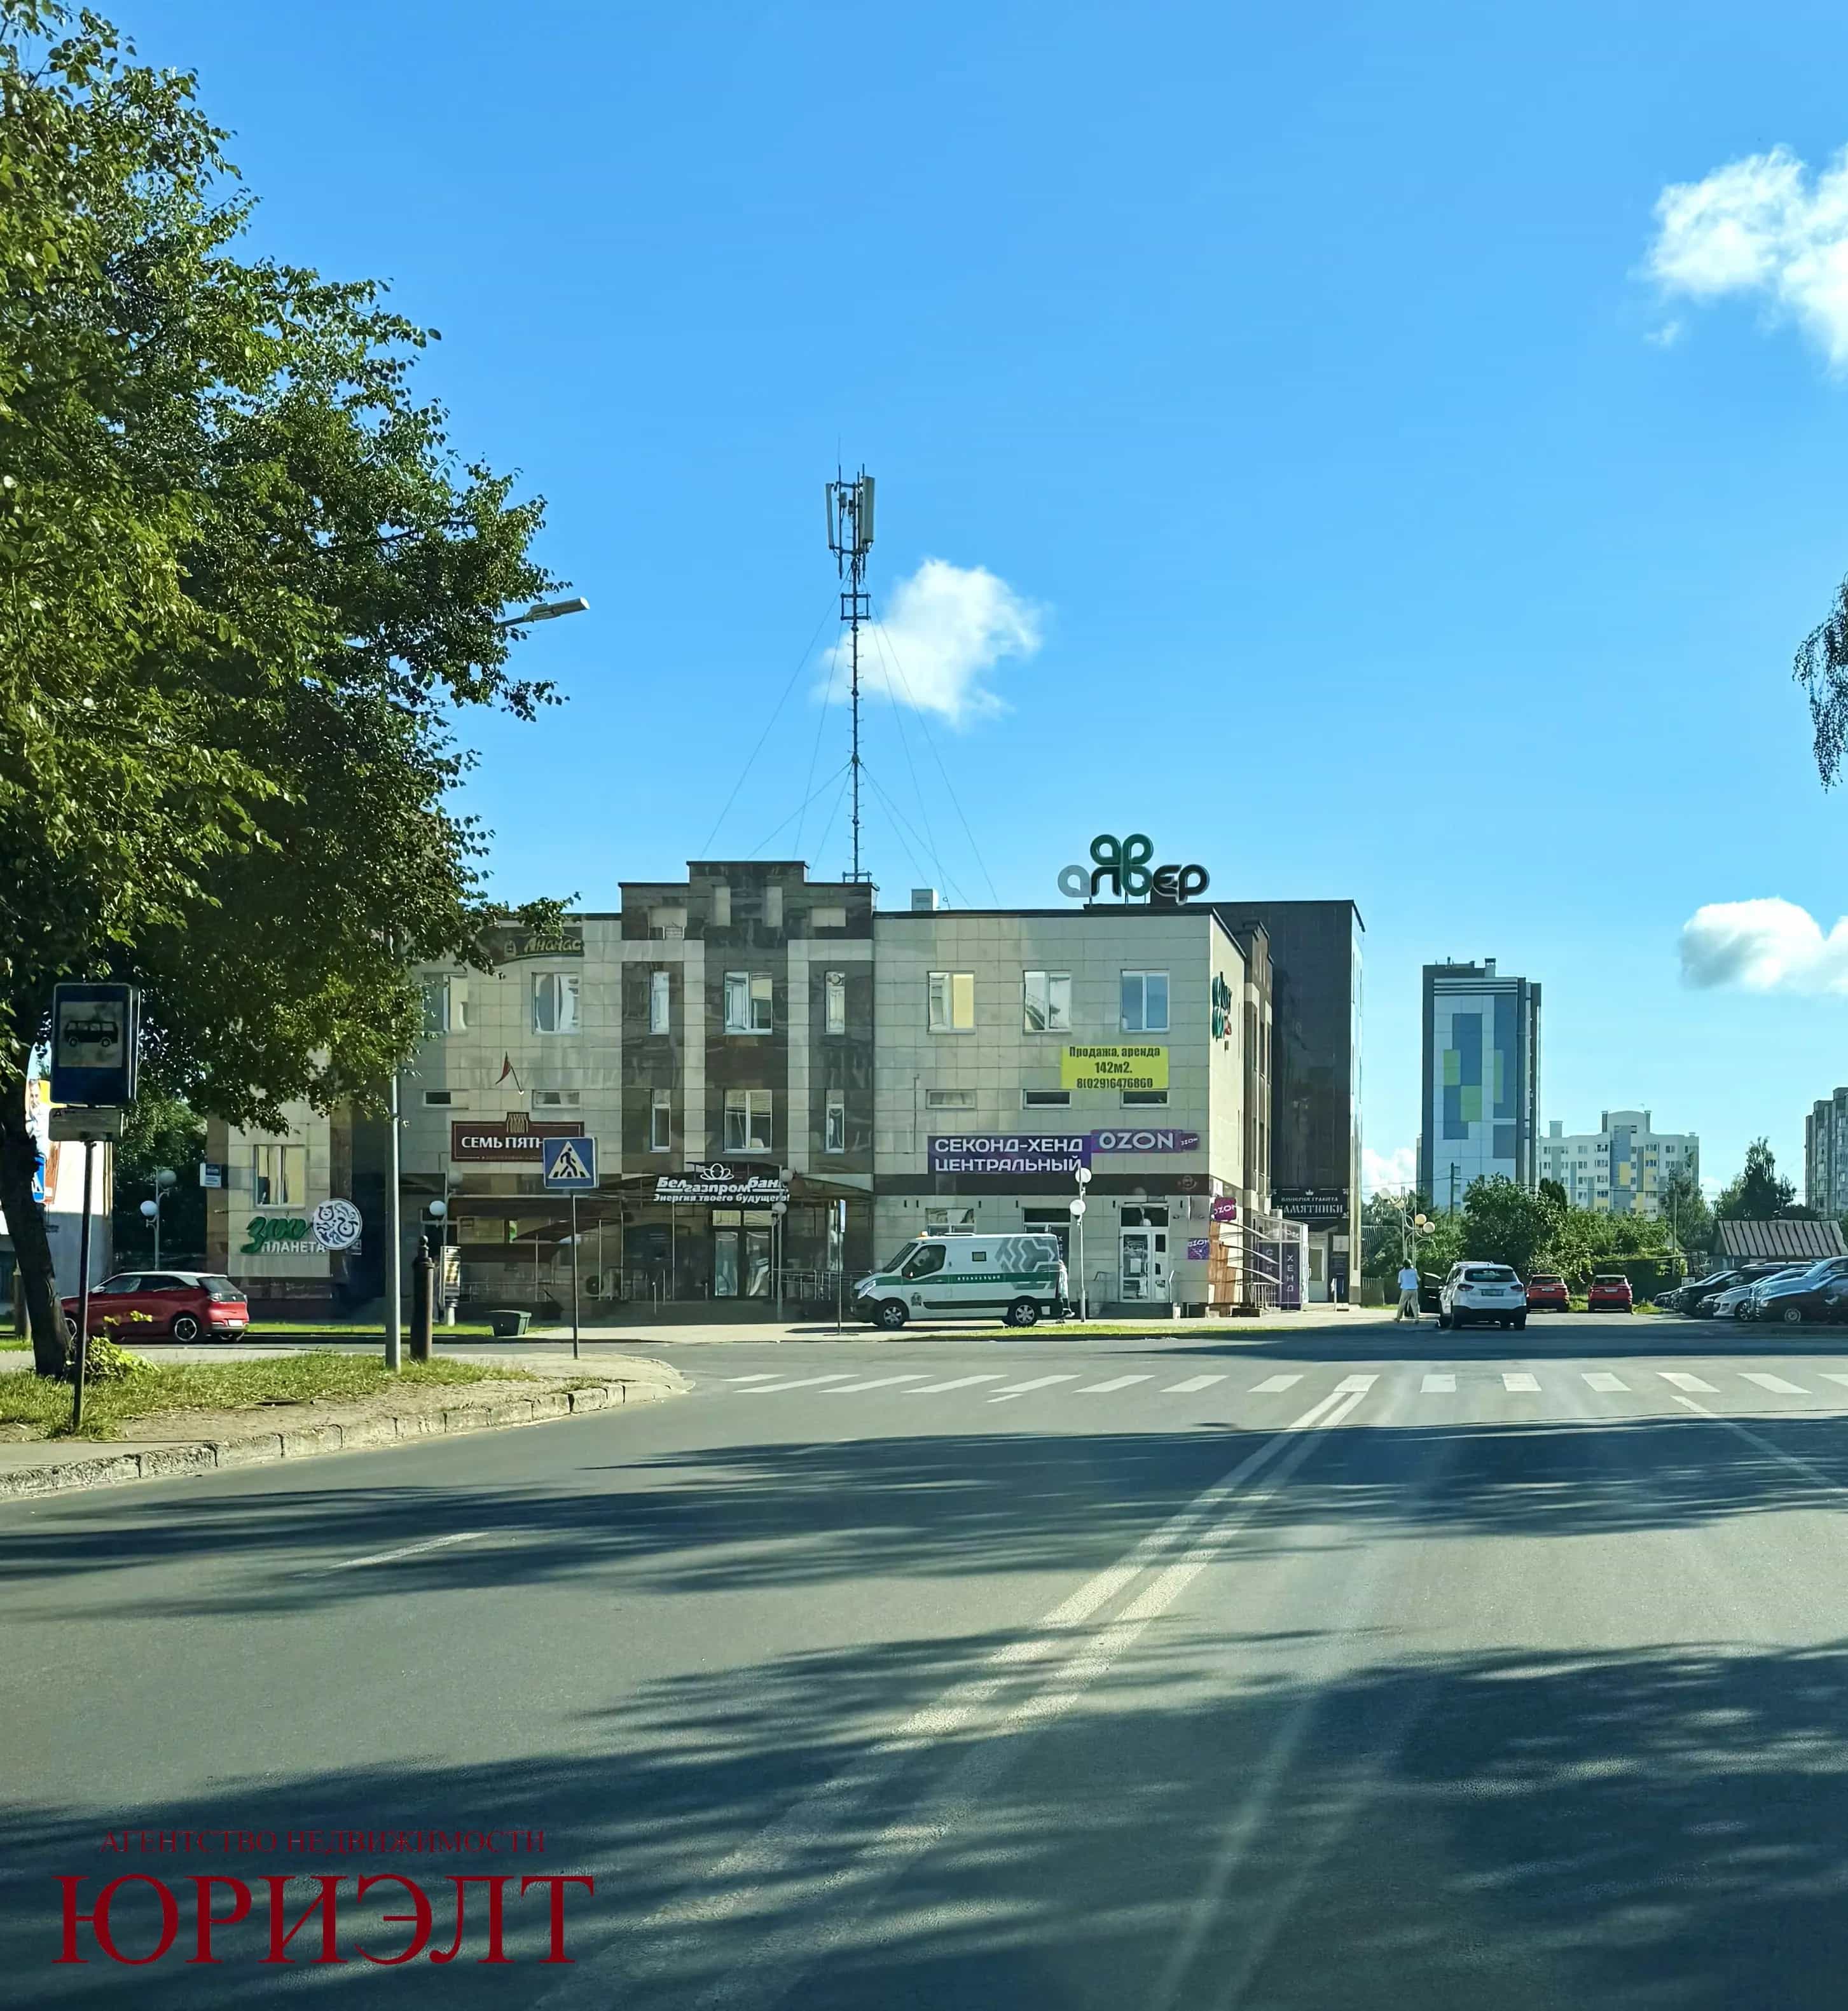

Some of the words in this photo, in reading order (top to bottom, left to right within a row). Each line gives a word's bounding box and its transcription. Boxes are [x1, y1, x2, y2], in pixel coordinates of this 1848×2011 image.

[1070, 1046, 1119, 1058] Продажа,
[1122, 1047, 1160, 1058] аренда
[1095, 1061, 1133, 1074] 142м2.
[462, 1137, 502, 1149] СЕМЬ
[506, 1137, 544, 1149] ПЯТН
[935, 1138, 1082, 1152] СЕКОНД-ХЕНД
[1099, 1132, 1173, 1149] OZON
[935, 1156, 1082, 1171] ЦЕНТРАЛЬНЫЙ
[656, 1176, 789, 1195] Белгазпромбан
[653, 1194, 696, 1202] Энергия
[262, 1241, 326, 1253] ПЛАНЕТА
